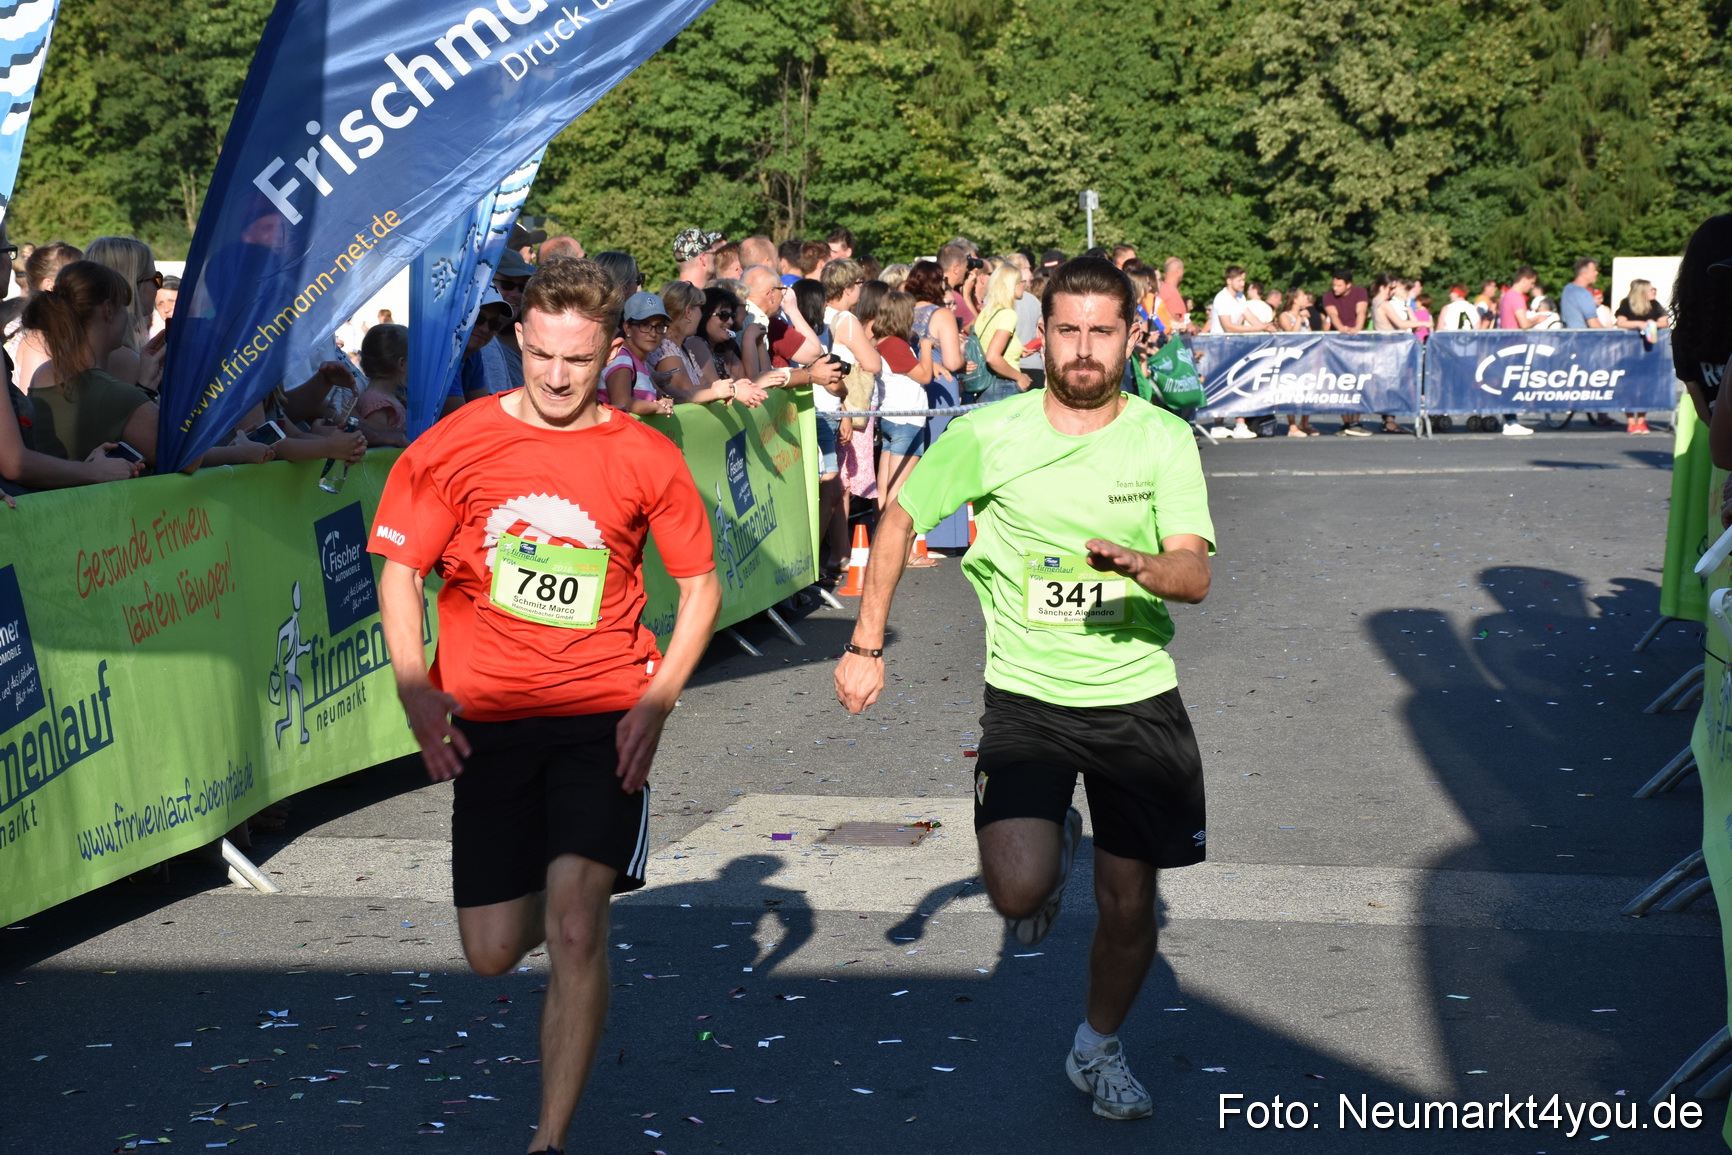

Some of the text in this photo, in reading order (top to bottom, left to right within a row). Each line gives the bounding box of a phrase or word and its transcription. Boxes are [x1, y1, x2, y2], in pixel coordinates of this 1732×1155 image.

[500, 6, 591, 81] Druck
[1252, 366, 1372, 391] Fischer
[1502, 364, 1625, 388] Fischer
[1263, 393, 1361, 404] AUTOMOBILE
[1512, 390, 1614, 401] AUTOMOBILE
[1116, 480, 1134, 488] Team
[1108, 492, 1138, 504] SMART
[376, 525, 406, 547] MARCO
[731, 482, 778, 567] firmenlauf
[76, 507, 214, 599] Gesunde Firmen
[329, 543, 361, 573] Fischer
[511, 548, 550, 564] firmenlauf
[334, 562, 361, 583] AUTOMOBILE
[1037, 564, 1074, 574] firmenlauf
[122, 540, 236, 647] laufen länger!
[517, 567, 579, 605] 780
[1045, 581, 1103, 608] 341
[511, 602, 555, 618] Hammerbacher
[555, 612, 574, 620] GmbH
[513, 594, 547, 611] Schmitz
[548, 604, 575, 614] Marco
[1075, 609, 1115, 617] Alejandro
[316, 681, 367, 732] neumarkt
[77, 751, 254, 861] www.firmenlauf-oberpfalz.de
